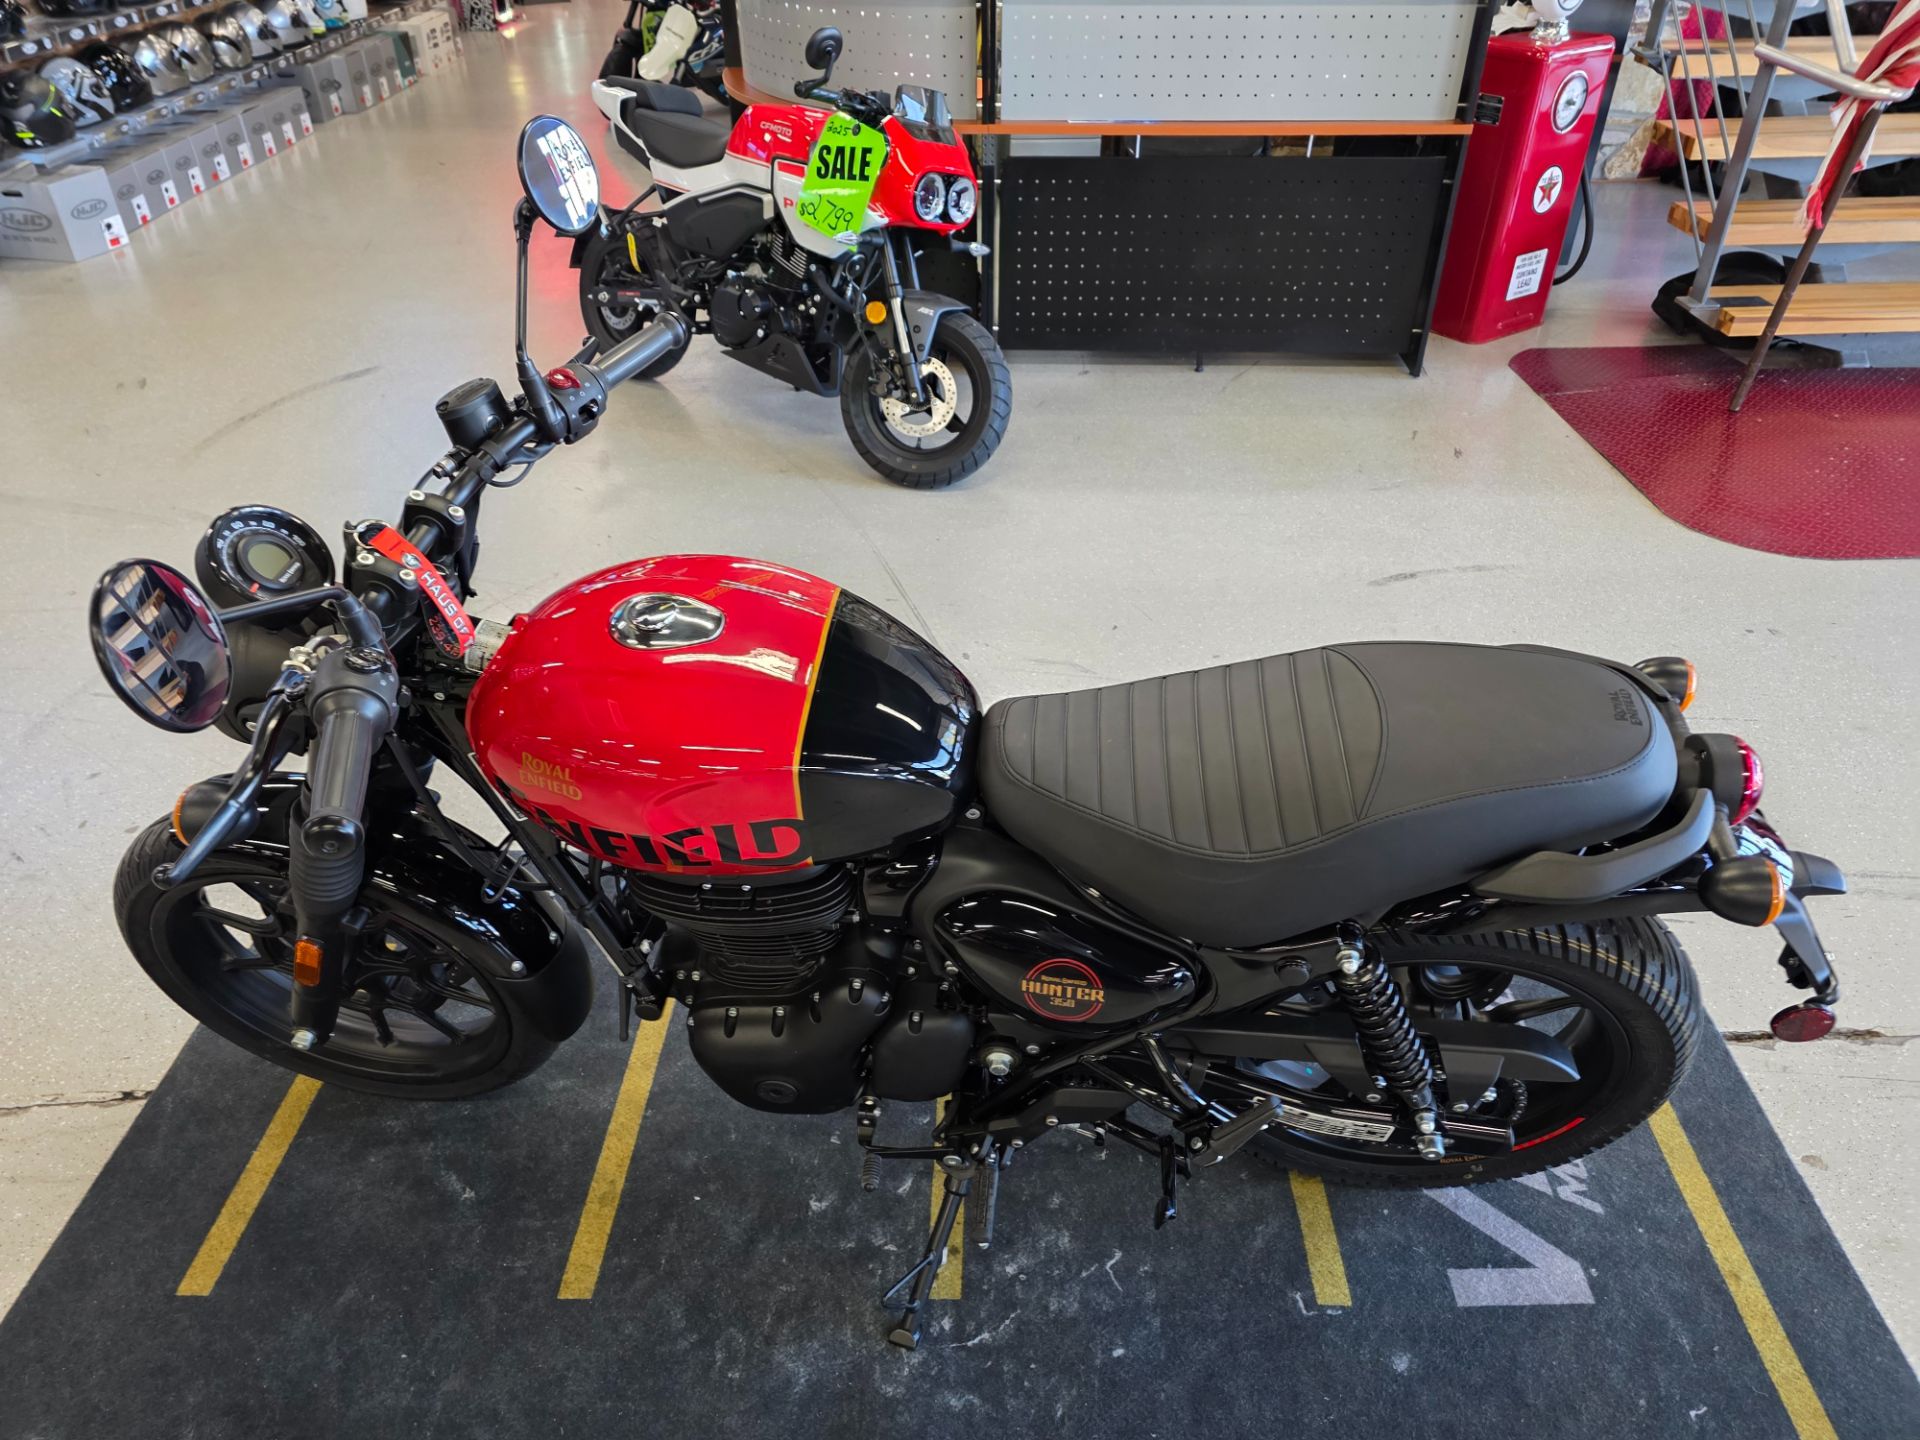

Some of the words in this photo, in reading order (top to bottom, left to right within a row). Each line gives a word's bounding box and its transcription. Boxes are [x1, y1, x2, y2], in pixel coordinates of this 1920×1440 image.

[760, 121, 793, 137] CFMOTO
[816, 144, 873, 182] SALE
[1, 212, 44, 227] HJC
[75, 201, 103, 217] HJC
[421, 570, 458, 619] HAUS
[521, 751, 575, 783] ROYAL
[518, 769, 583, 801] ENFIELD
[515, 797, 808, 866] NFIELD
[1021, 979, 1105, 1003] HUNTER
